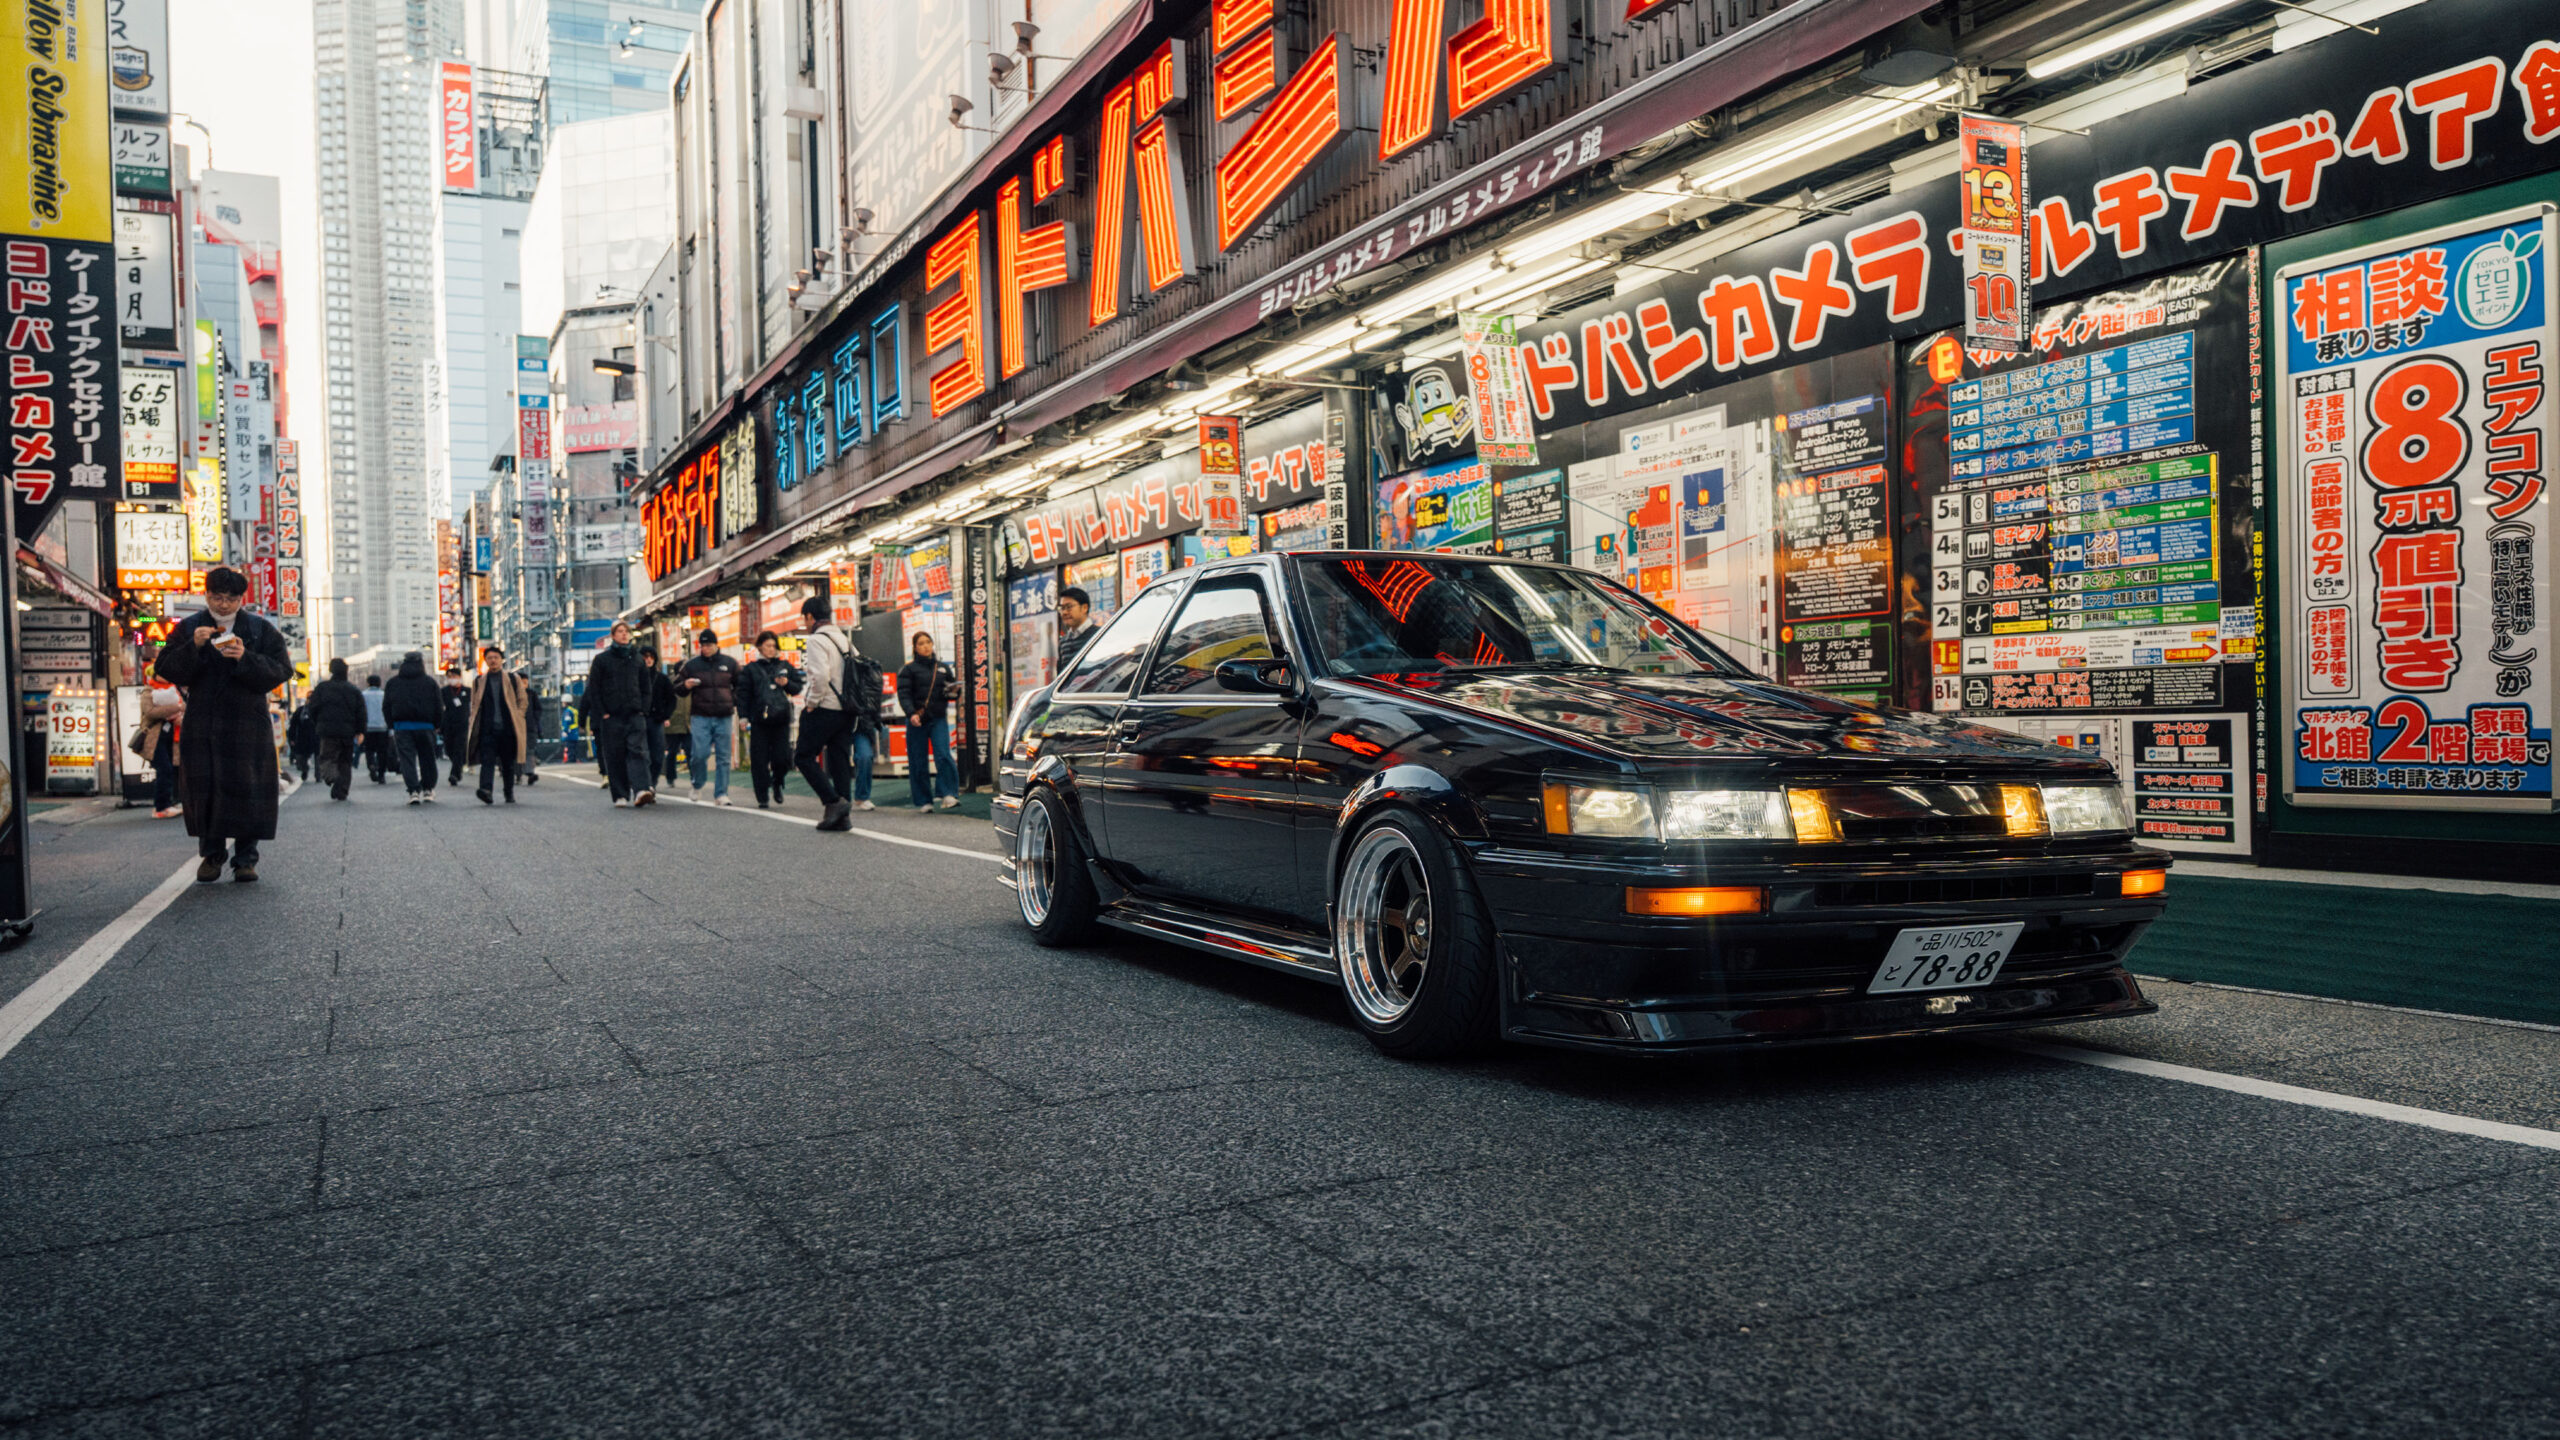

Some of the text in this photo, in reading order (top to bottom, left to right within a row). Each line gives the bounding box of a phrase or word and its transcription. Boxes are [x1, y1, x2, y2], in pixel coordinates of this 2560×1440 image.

[67, 26, 77, 62] BASE
[25, 0, 69, 223] llow Submarine
[446, 88, 473, 174] カラオケ
[1948, 38, 2560, 285] ルチメディア
[1963, 167, 2019, 219] 13%
[925, 0, 1690, 419] ヨドバシカ
[1258, 227, 1396, 320] ヨドバシカメラ
[2475, 256, 2510, 270] TOKYO
[2474, 270, 2510, 288] ゼロ
[1967, 272, 2020, 325] 10%
[2166, 298, 2197, 313] (EAST)
[2292, 247, 2449, 343] 相談
[2475, 286, 2510, 305] エミ
[2475, 303, 2511, 317] ポイント
[125, 326, 147, 338] 3F
[2314, 316, 2433, 363] 承ります
[65, 248, 107, 488] ケータイアクセサリー館
[1936, 341, 1955, 379] E
[6, 241, 55, 505] ヨドバシカメラ
[2299, 371, 2352, 395] 対象者
[776, 300, 902, 492] 新宿西口
[2069, 382, 2086, 395] EMS
[1833, 418, 1861, 431] iPhone
[2304, 398, 2324, 453] お住まいの
[2325, 393, 2346, 453] 東京都に
[2482, 340, 2547, 522] エアコン
[234, 417, 252, 513] 買取センター
[1985, 452, 2009, 472] テレビ
[131, 482, 151, 496] B1
[277, 440, 300, 557] ヨドバシカメラ
[199, 485, 218, 558] おたからや
[1023, 472, 1169, 565] ヨドバシカメラ
[2310, 461, 2344, 576] 高齢者の方
[1994, 523, 2046, 545] 電子ピアノ
[2084, 531, 2118, 551] レンジ
[2084, 550, 2119, 569] 掃除機
[124, 571, 172, 586] かのや
[1993, 576, 2044, 591] 映像ソフト
[2083, 572, 2121, 588] PCソフト
[2313, 577, 2345, 588] 65歳
[2084, 592, 2111, 607] エアコン
[2317, 586, 2338, 596] 以上
[2029, 635, 2063, 646] パソコン
[2311, 609, 2328, 675] お持ちの方
[2328, 607, 2347, 688] 障害者手帳を
[1993, 650, 2033, 660] シェーバー
[2028, 686, 2048, 697] マウス
[52, 716, 90, 734] 199
[2152, 721, 2209, 734] スマートフォン
[2302, 711, 2369, 725] マルチメディア
[2300, 725, 2371, 762] 北館
[2472, 708, 2528, 735] 家電
[2321, 767, 2528, 790] ご相談・申請を承ります
[1884, 950, 2001, 988] と 78-88
